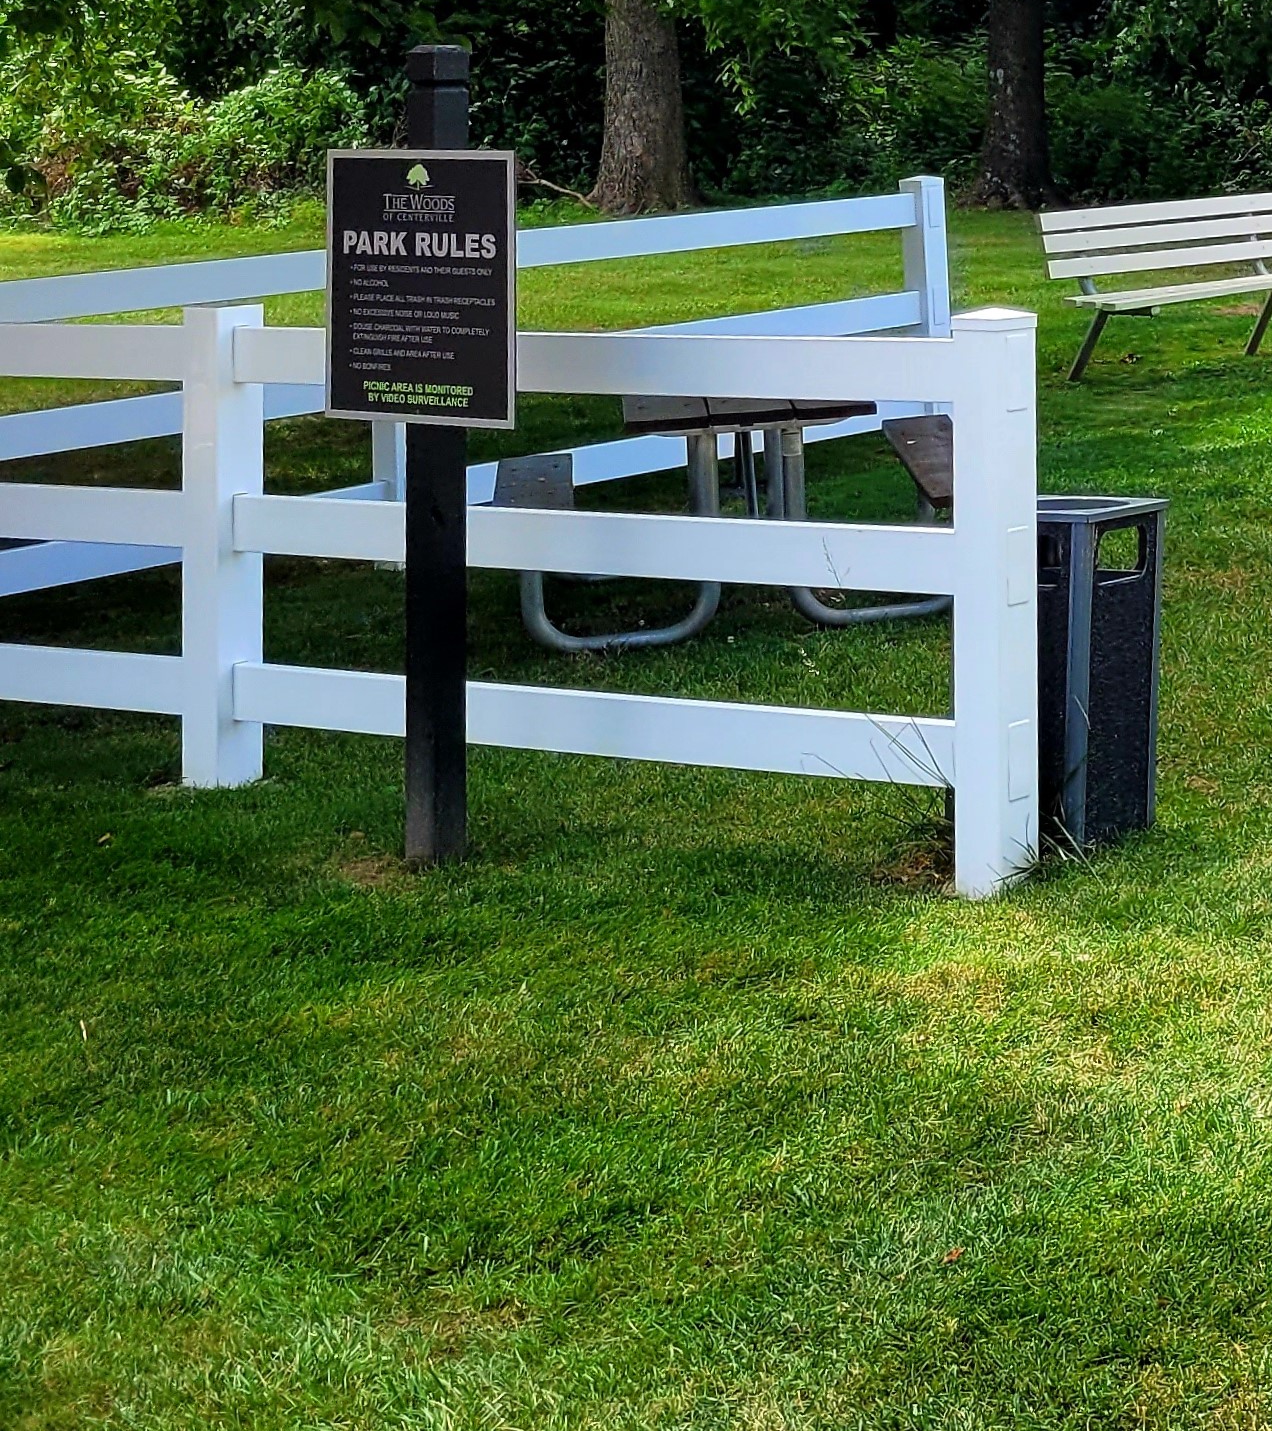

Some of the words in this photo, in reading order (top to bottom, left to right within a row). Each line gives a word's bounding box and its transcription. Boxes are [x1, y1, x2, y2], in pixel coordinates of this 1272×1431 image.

[383, 194, 407, 209] THE
[410, 194, 455, 210] WOODS
[397, 214, 454, 222] CENTERVILLE
[343, 230, 407, 256] PARK
[416, 232, 496, 259] RULES
[363, 381, 389, 391] PICNIC
[391, 382, 413, 392] AREA
[415, 383, 423, 393] IS
[425, 384, 473, 396] MONITORED
[368, 393, 379, 402] BY
[380, 393, 405, 404] VIDEO
[408, 394, 469, 407] SURVEILLANCE
